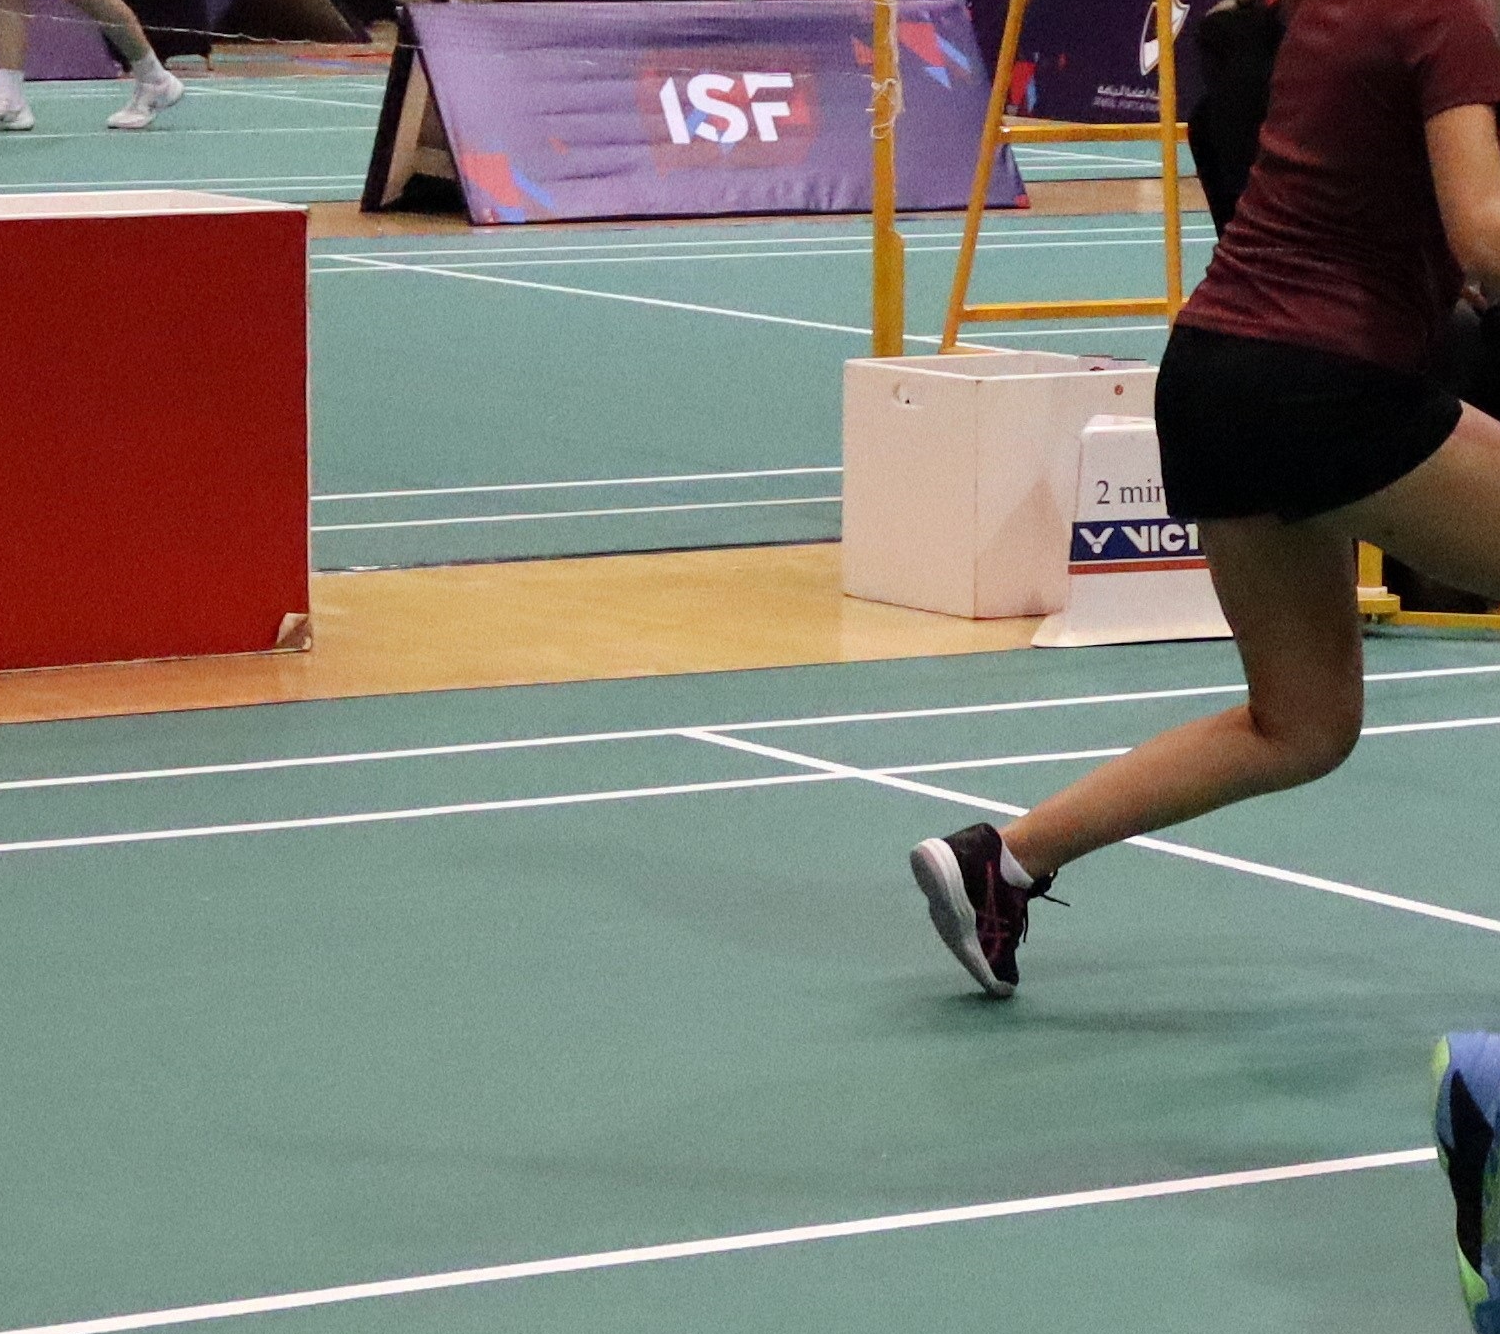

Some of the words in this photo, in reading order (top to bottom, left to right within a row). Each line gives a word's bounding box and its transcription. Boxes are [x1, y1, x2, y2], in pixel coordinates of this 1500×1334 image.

[659, 71, 794, 144] ISF
[1096, 480, 1111, 505] 2
[1120, 523, 1200, 553] VICT
